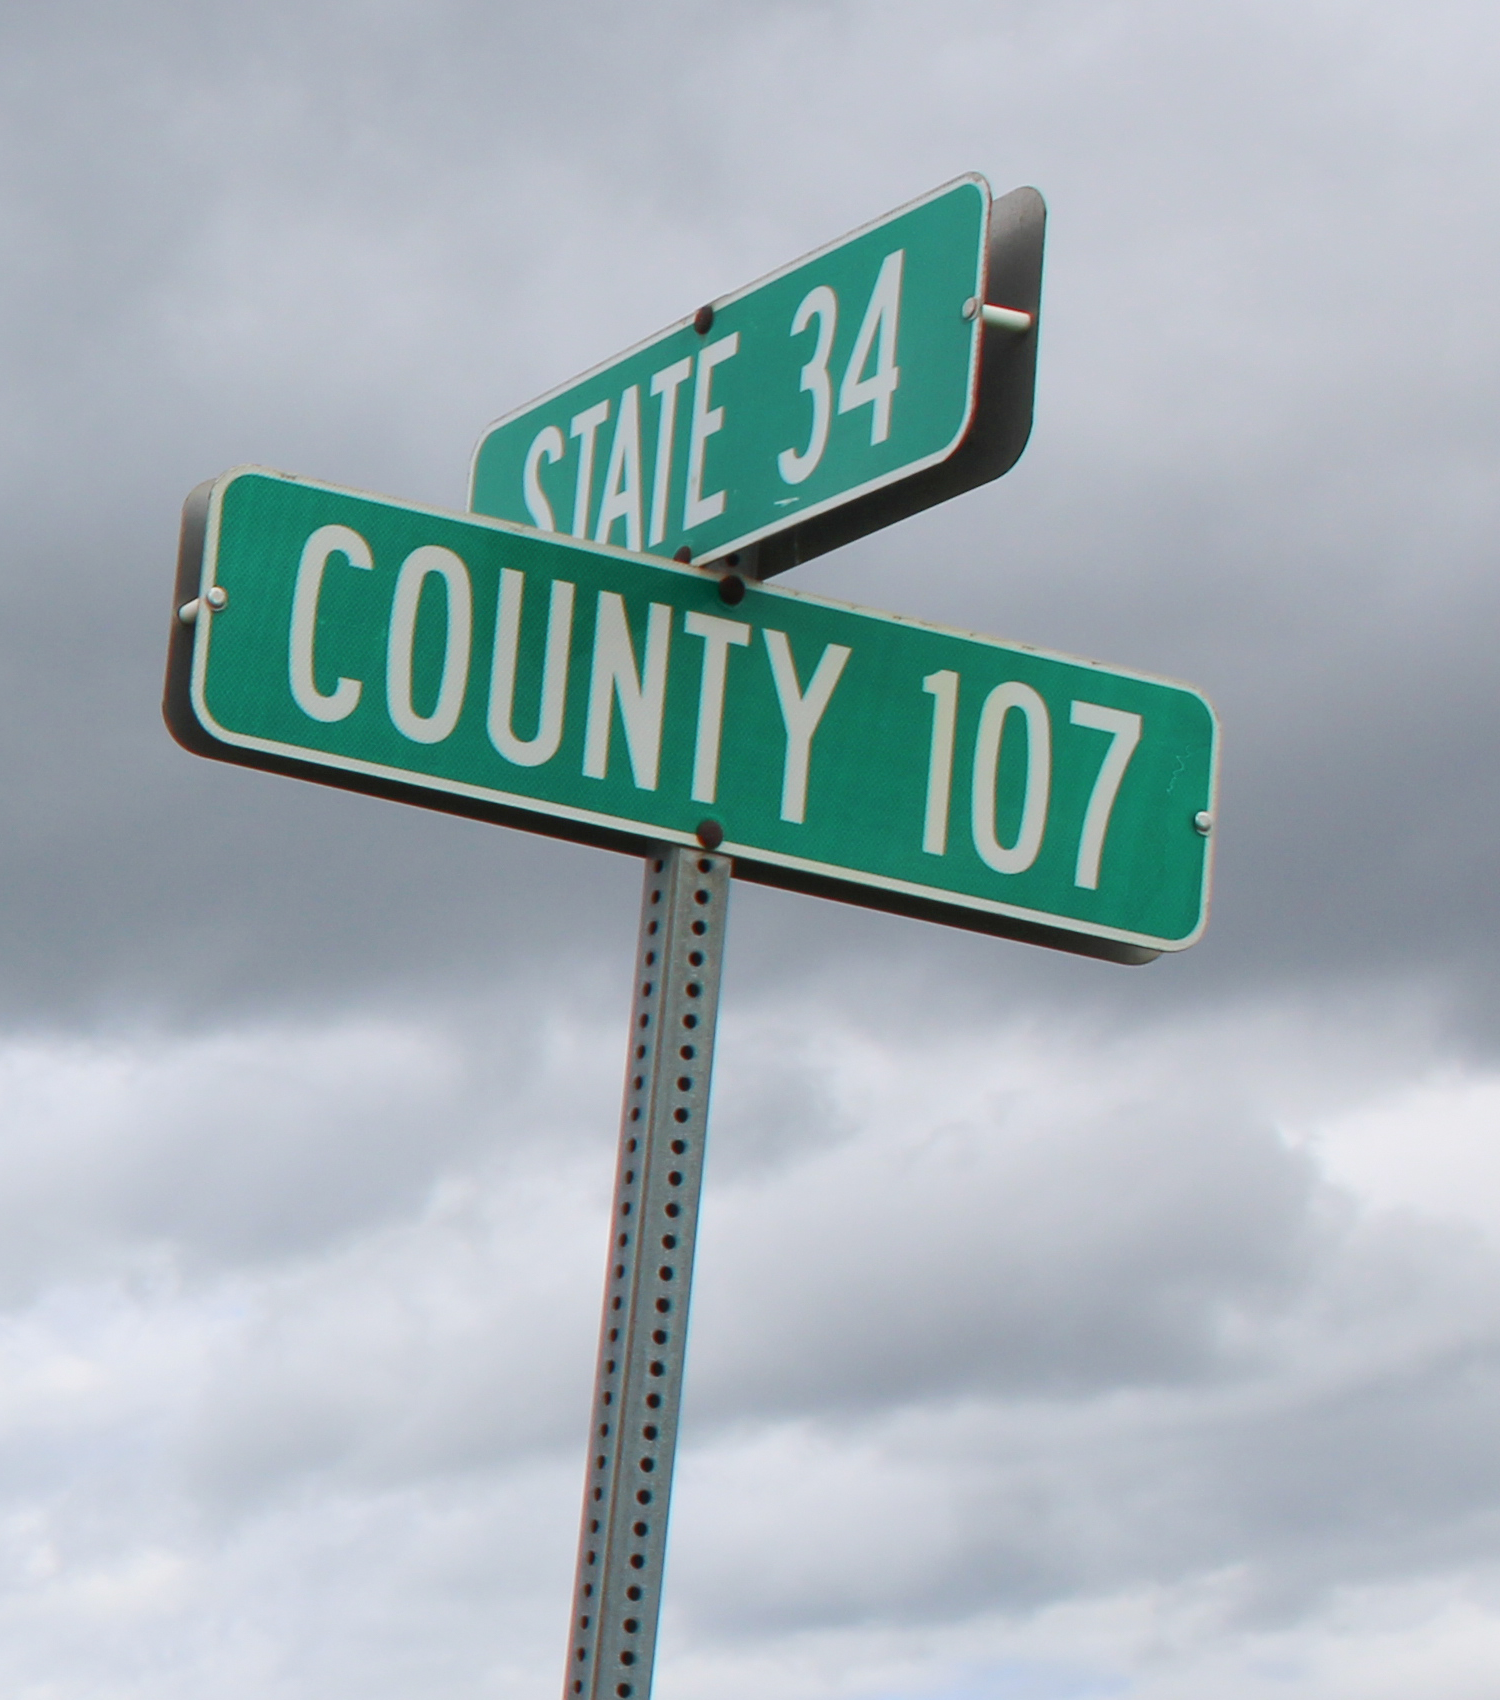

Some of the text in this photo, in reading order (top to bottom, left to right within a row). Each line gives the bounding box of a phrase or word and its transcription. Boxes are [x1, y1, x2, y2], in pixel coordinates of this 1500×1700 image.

[523, 248, 905, 553] STATE 34
[287, 523, 1142, 890] COUNTY 107
